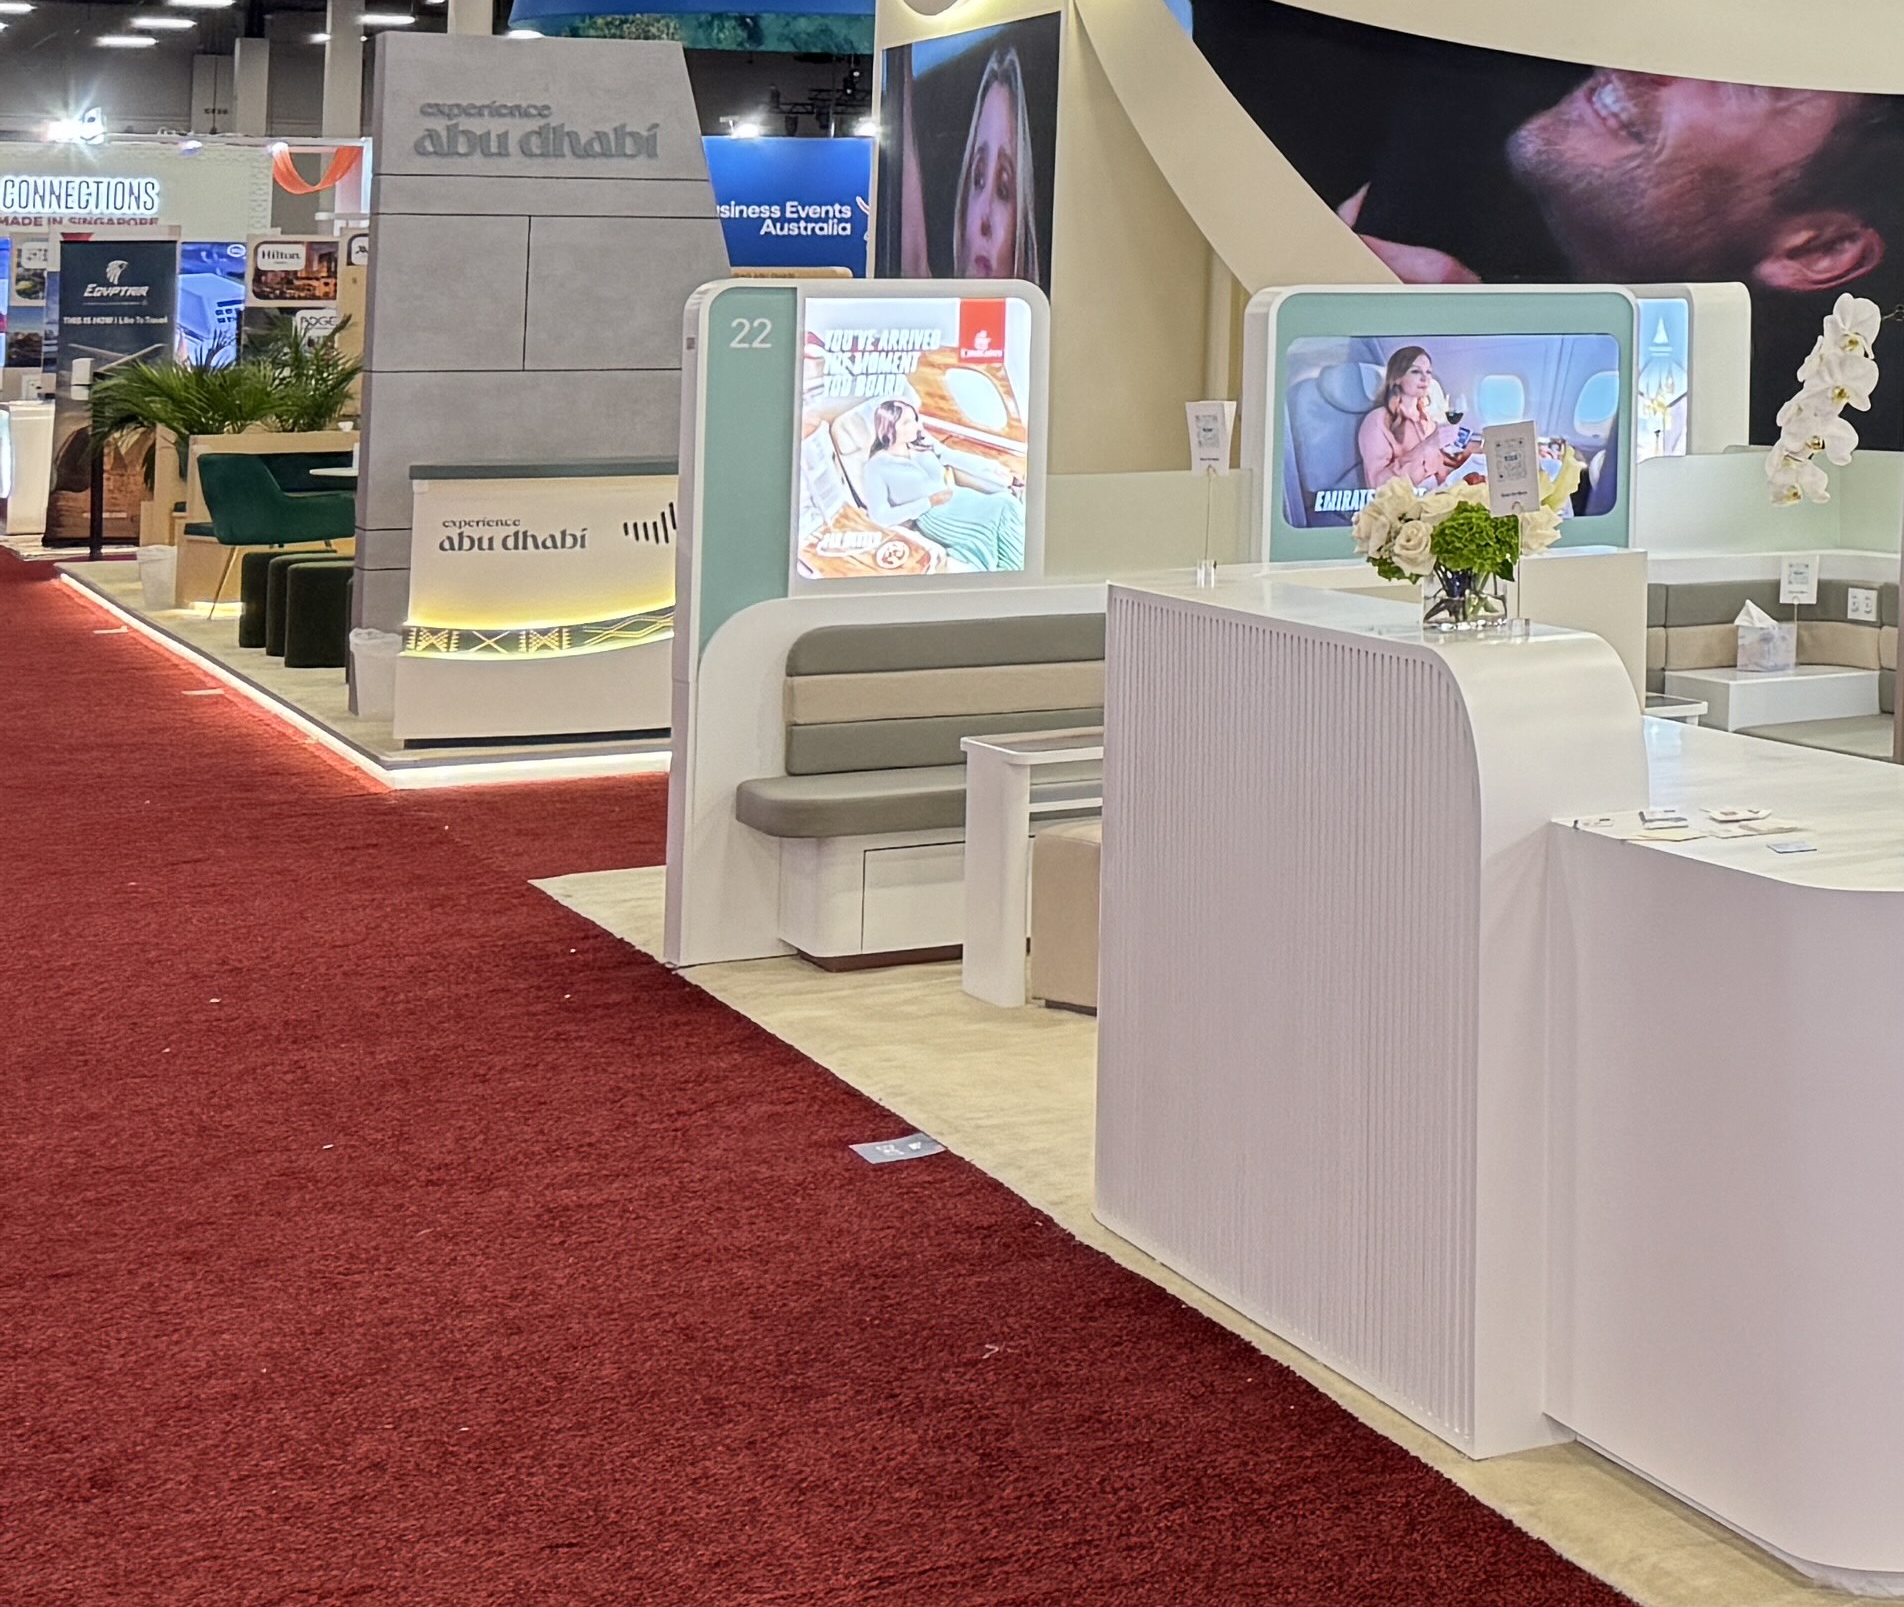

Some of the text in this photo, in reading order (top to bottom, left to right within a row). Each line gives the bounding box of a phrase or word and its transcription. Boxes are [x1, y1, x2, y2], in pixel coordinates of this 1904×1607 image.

[420, 100, 552, 121] experience
[414, 121, 660, 159] abu dhabi
[2, 179, 156, 211] CONNECTIONS
[716, 200, 852, 219] siness Events
[48, 216, 63, 226] IN
[760, 219, 851, 236] Australia
[730, 317, 773, 349] 22
[442, 516, 521, 531] experience
[439, 527, 588, 552] abu dhabi
